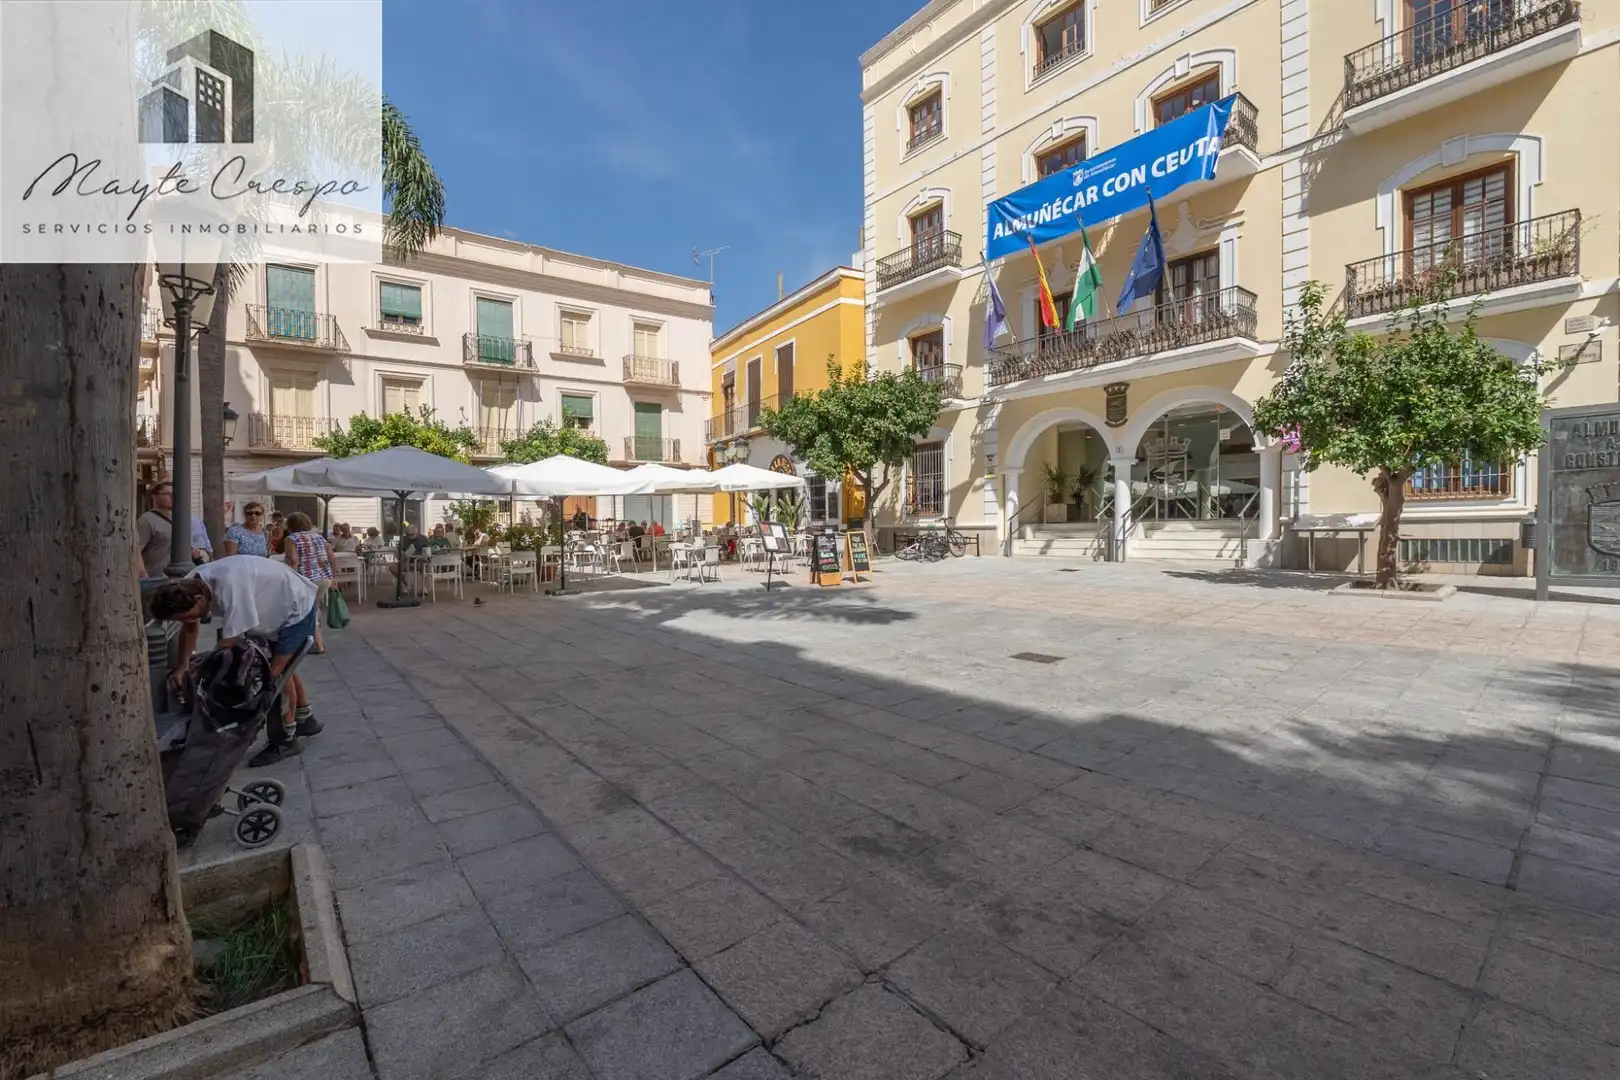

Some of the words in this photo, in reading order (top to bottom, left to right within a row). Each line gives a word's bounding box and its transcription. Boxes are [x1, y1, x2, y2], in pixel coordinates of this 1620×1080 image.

[993, 185, 1099, 241] ALMUÑÉCAR
[1102, 164, 1147, 198] CON
[1151, 135, 1221, 179] CEUTA
[1565, 450, 1620, 469] CONST
